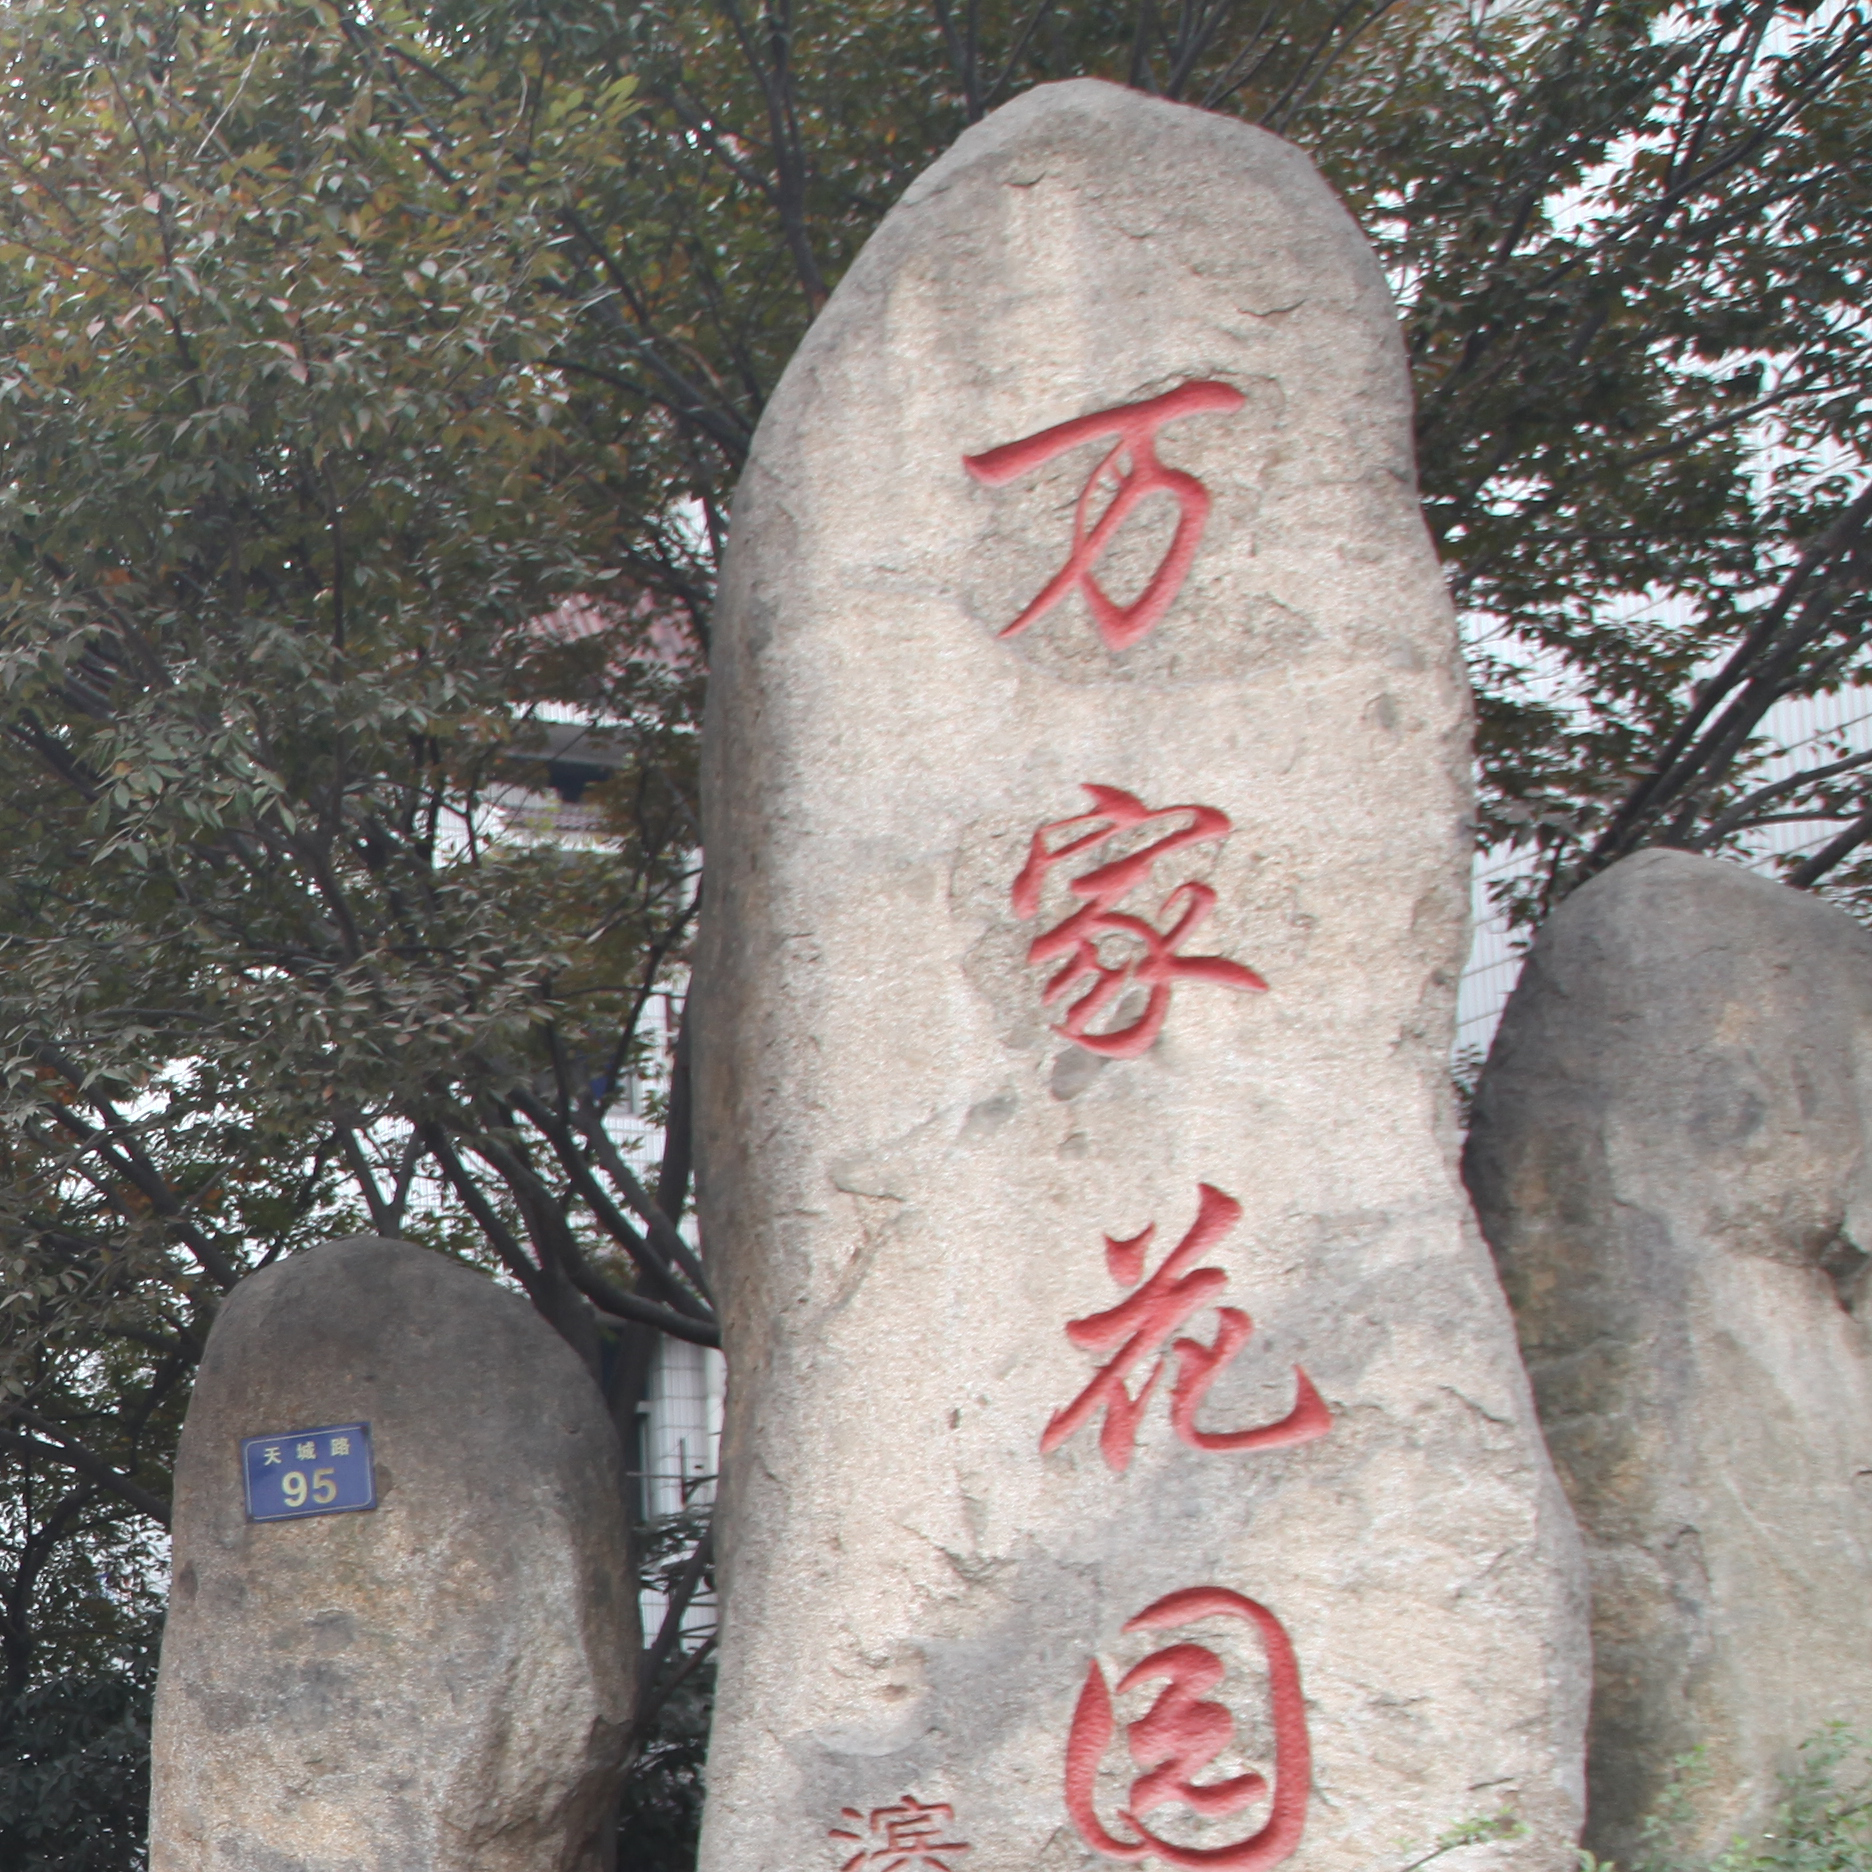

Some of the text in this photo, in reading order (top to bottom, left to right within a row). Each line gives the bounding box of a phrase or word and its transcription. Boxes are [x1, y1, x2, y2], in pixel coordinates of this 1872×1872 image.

[262, 1437, 351, 1467] 天城路
[281, 1467, 338, 1508] 95
